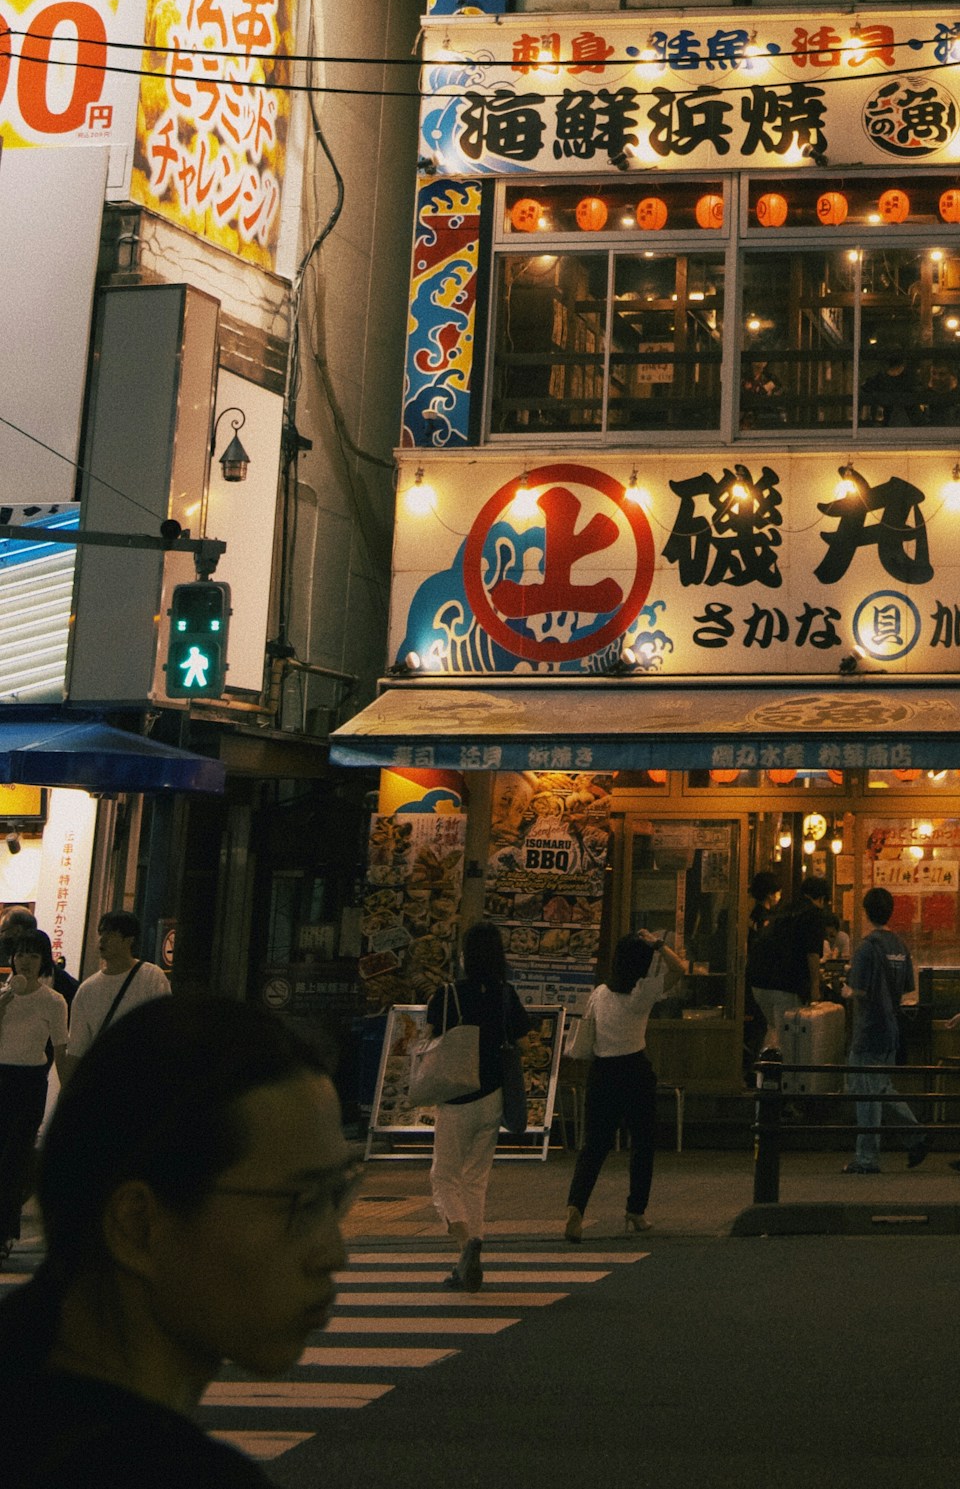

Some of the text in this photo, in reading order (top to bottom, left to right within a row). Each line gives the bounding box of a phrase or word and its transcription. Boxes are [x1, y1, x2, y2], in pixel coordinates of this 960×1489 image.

[459, 85, 828, 161] 海鮮浜焼
[693, 603, 841, 648] さかな
[526, 838, 571, 849] ISOMARU
[525, 850, 569, 872] BBQ
